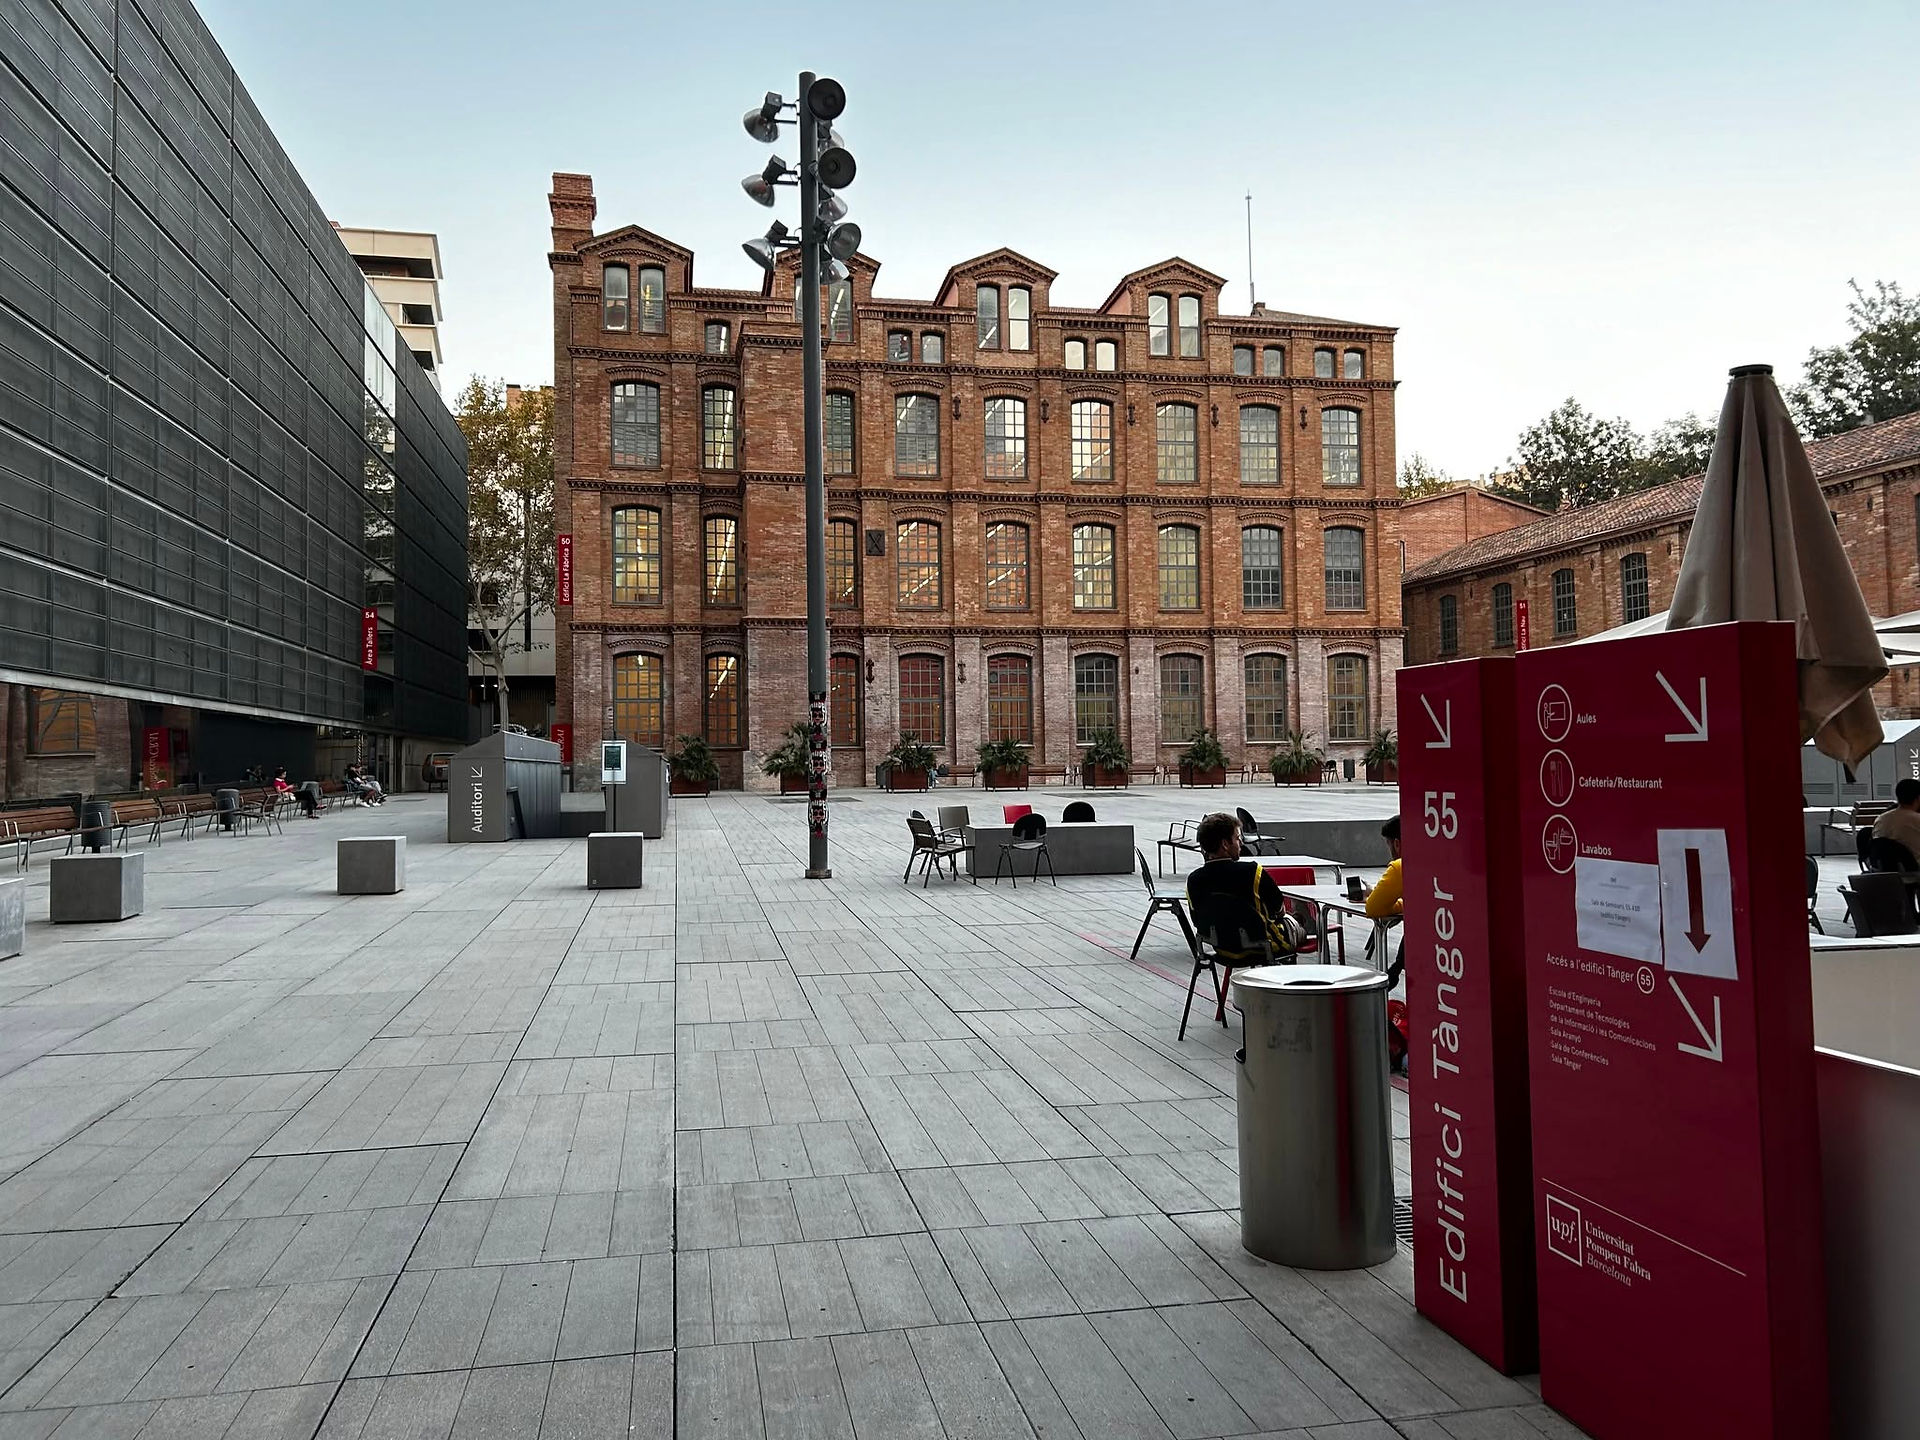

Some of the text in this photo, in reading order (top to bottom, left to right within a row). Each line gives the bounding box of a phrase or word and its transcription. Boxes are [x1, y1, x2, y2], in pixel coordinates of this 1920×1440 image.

[561, 537, 571, 545] 50
[563, 572, 570, 581] La
[365, 611, 375, 619] 54
[365, 626, 374, 649] Tallers
[1576, 713, 1597, 725] Aules
[1578, 776, 1663, 790] Cafeteria/Restaurant
[470, 782, 483, 833] Auditori
[1424, 791, 1459, 840] 55
[1581, 843, 1612, 856] Lavabos
[1546, 952, 1652, 987] Accés a l'edifici Tànger 55
[1549, 986, 1567, 998] Escola
[1549, 1000, 1631, 1029] Departament de Tecnologies
[1550, 1026, 1562, 1037] Sala
[1550, 1014, 1558, 1023] de
[1608, 1030, 1656, 1051] Comunicacions
[1551, 1040, 1562, 1051] Sala
[1551, 1053, 1563, 1064] Sala
[1432, 877, 1468, 1304] Edifici Tànger
[1585, 1219, 1635, 1256] Universitat
[1586, 1235, 1651, 1281] Pompeu Fabra
[1586, 1252, 1632, 1287] Barcelona
